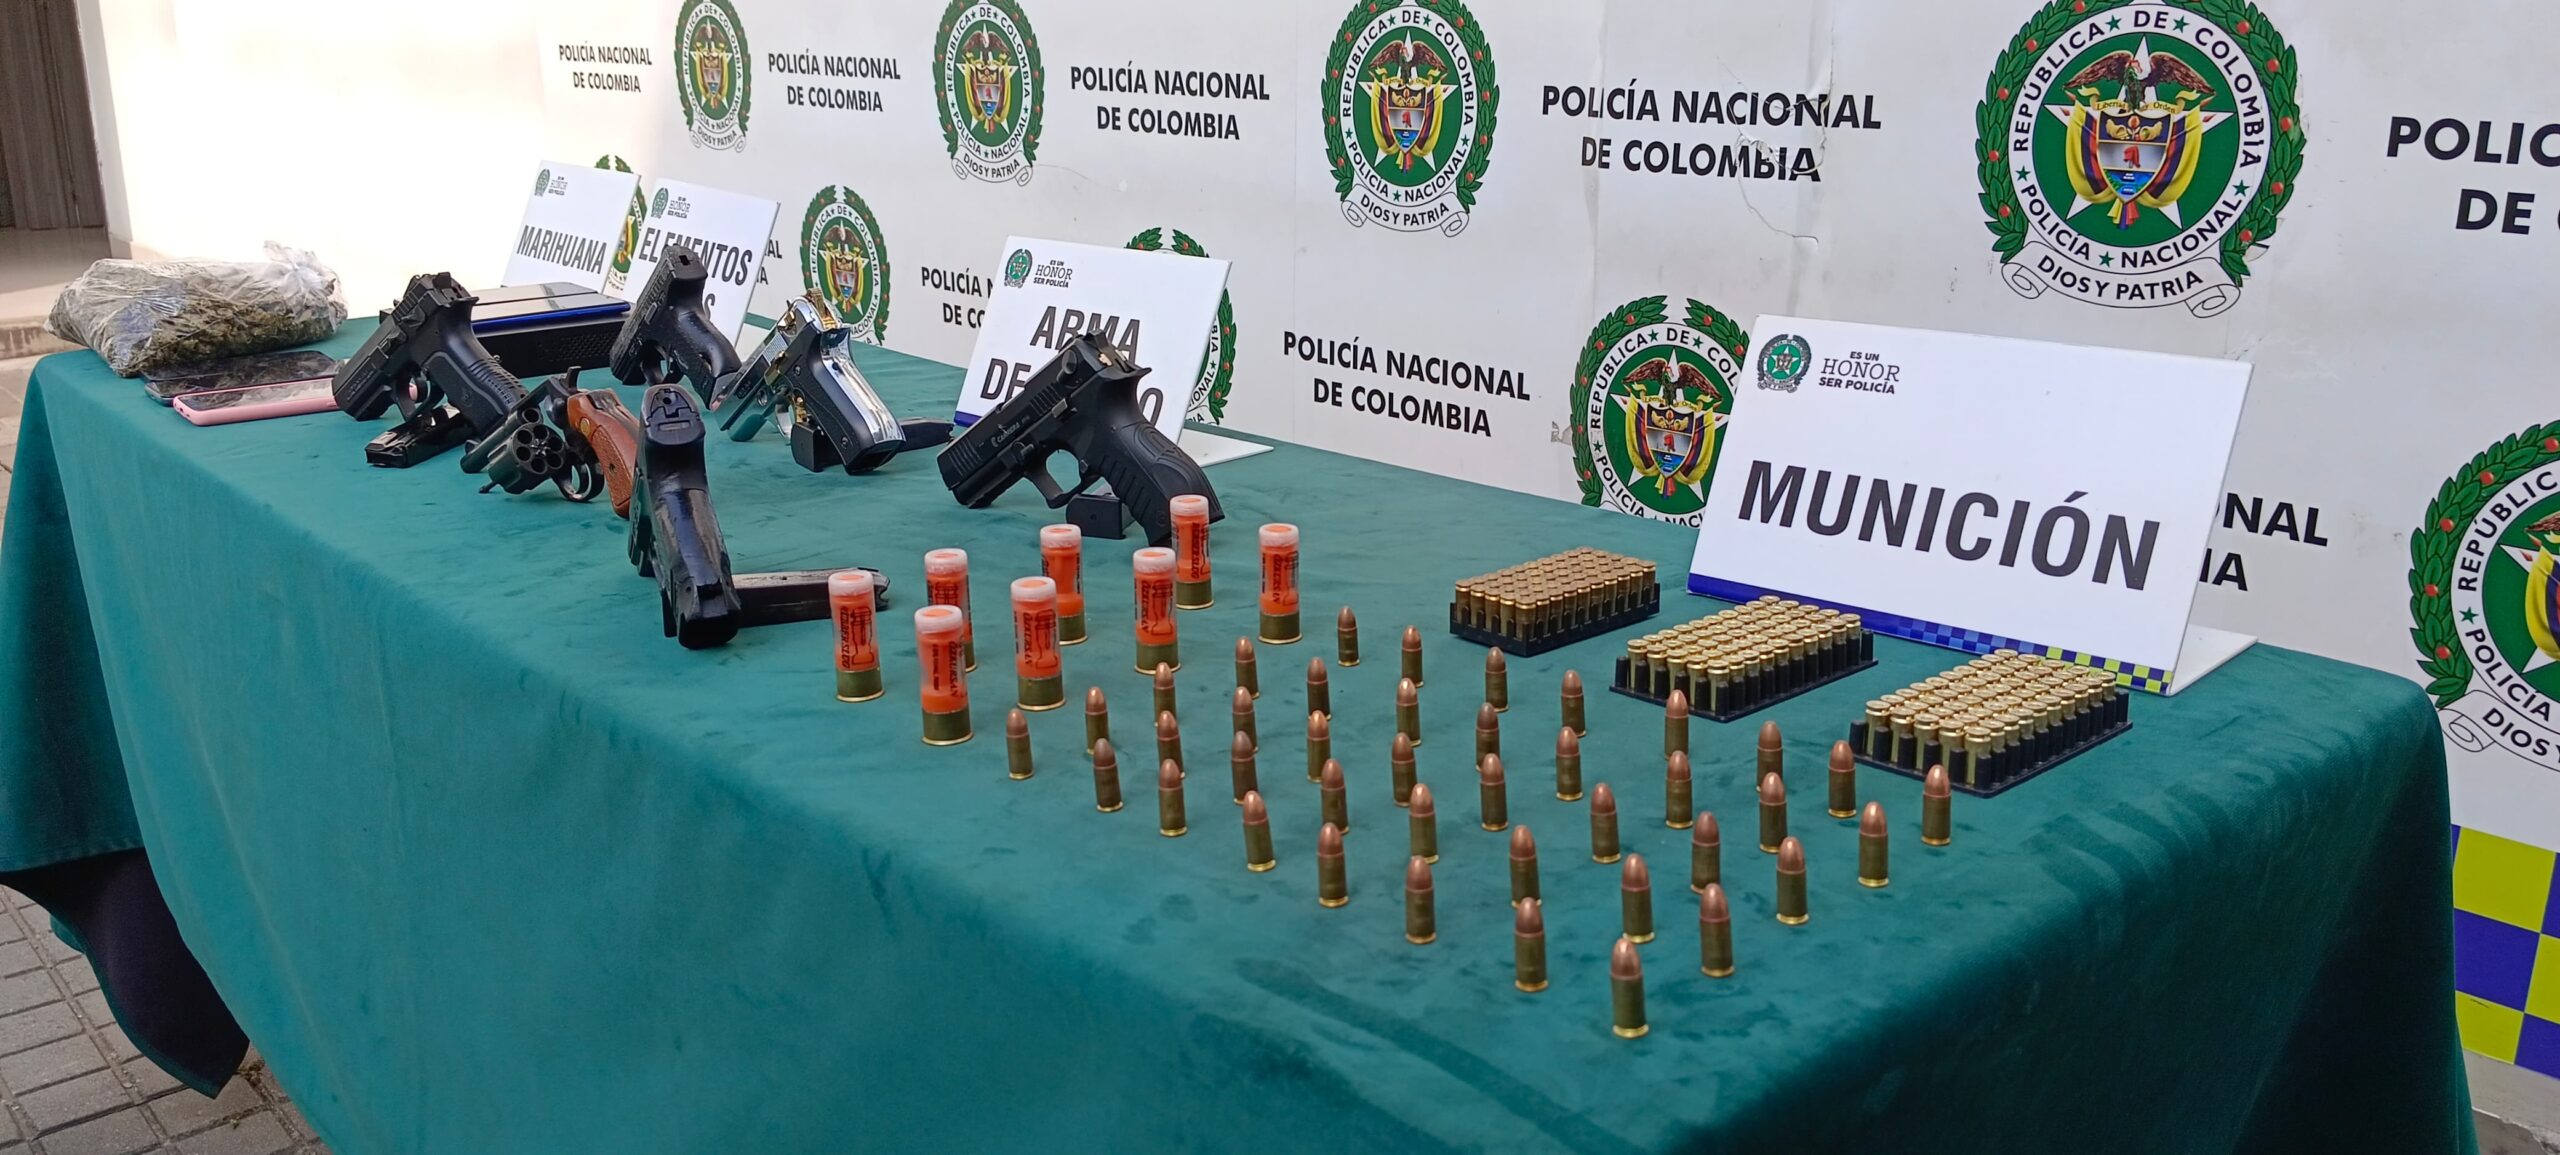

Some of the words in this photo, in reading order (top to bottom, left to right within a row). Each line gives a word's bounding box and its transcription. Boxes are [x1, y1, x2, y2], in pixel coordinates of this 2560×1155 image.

[704, 4, 713, 14] DE
[598, 46, 652, 65] NACIONAL
[768, 48, 820, 75] POLICÍA
[824, 55, 901, 80] NACIONAL
[979, 7, 992, 18] DE
[1000, 16, 1030, 98] COLOMBIA
[1402, 10, 1421, 24] DE
[1434, 22, 1474, 125] COLOMBIA
[573, 71, 585, 88] DE
[588, 72, 641, 93] COLOMBIA
[787, 85, 804, 106] DE
[808, 87, 883, 112] COLOMBIA
[1071, 60, 1148, 94] POLICÍA
[1154, 70, 1270, 100] NACIONAL
[2013, 22, 2105, 152] REPÚBLICA
[2133, 10, 2169, 29] DE
[2194, 27, 2265, 168] COLOMBIA
[1097, 105, 1121, 131] DE
[1128, 107, 1240, 140] COLOMBIA
[1542, 78, 1660, 122] POLICÍA
[1672, 90, 1882, 130] NACIONAL
[990, 116, 1028, 159] NACIONAL
[1581, 136, 1612, 169] DE
[1622, 139, 1821, 182] COLOMBIA
[991, 159, 1020, 178] PATRIA
[1404, 148, 1467, 202] NACIONAL
[1360, 194, 1390, 222] DIOS
[1391, 213, 1400, 225] Y
[1403, 202, 1450, 226] PATRIA
[2455, 188, 2536, 235] DE
[516, 224, 607, 274] MARIHUANA
[837, 205, 847, 216] DE
[854, 216, 879, 286] COLOMBIA
[2120, 198, 2242, 269] NACIONAL
[921, 266, 982, 297] POLICÍA
[1035, 264, 1073, 280] HONOR
[2036, 254, 2090, 294] DIOS
[2094, 280, 2110, 298] Y
[2116, 270, 2204, 300] PATRIA
[942, 302, 963, 326] DE
[1284, 331, 1377, 374] POLICÍA
[1386, 350, 1531, 401] NACIONAL
[1591, 332, 1649, 429] REPÚBLICA
[1666, 327, 1690, 344] DE
[1820, 358, 1900, 382] HONOR
[1850, 351, 1862, 360] ES
[1865, 352, 1880, 361] UN
[980, 358, 1031, 402] DE
[1190, 371, 1215, 406] IONAL
[1818, 377, 1843, 388] SER
[1845, 380, 1896, 395] POLICÍA
[1313, 378, 1343, 408] DE
[1351, 385, 1492, 437] COLOMBIA
[1738, 460, 2160, 591] MUNICIÓN
[2457, 471, 2558, 591] REPÚBLIC
[2482, 707, 2550, 756] DIOS
